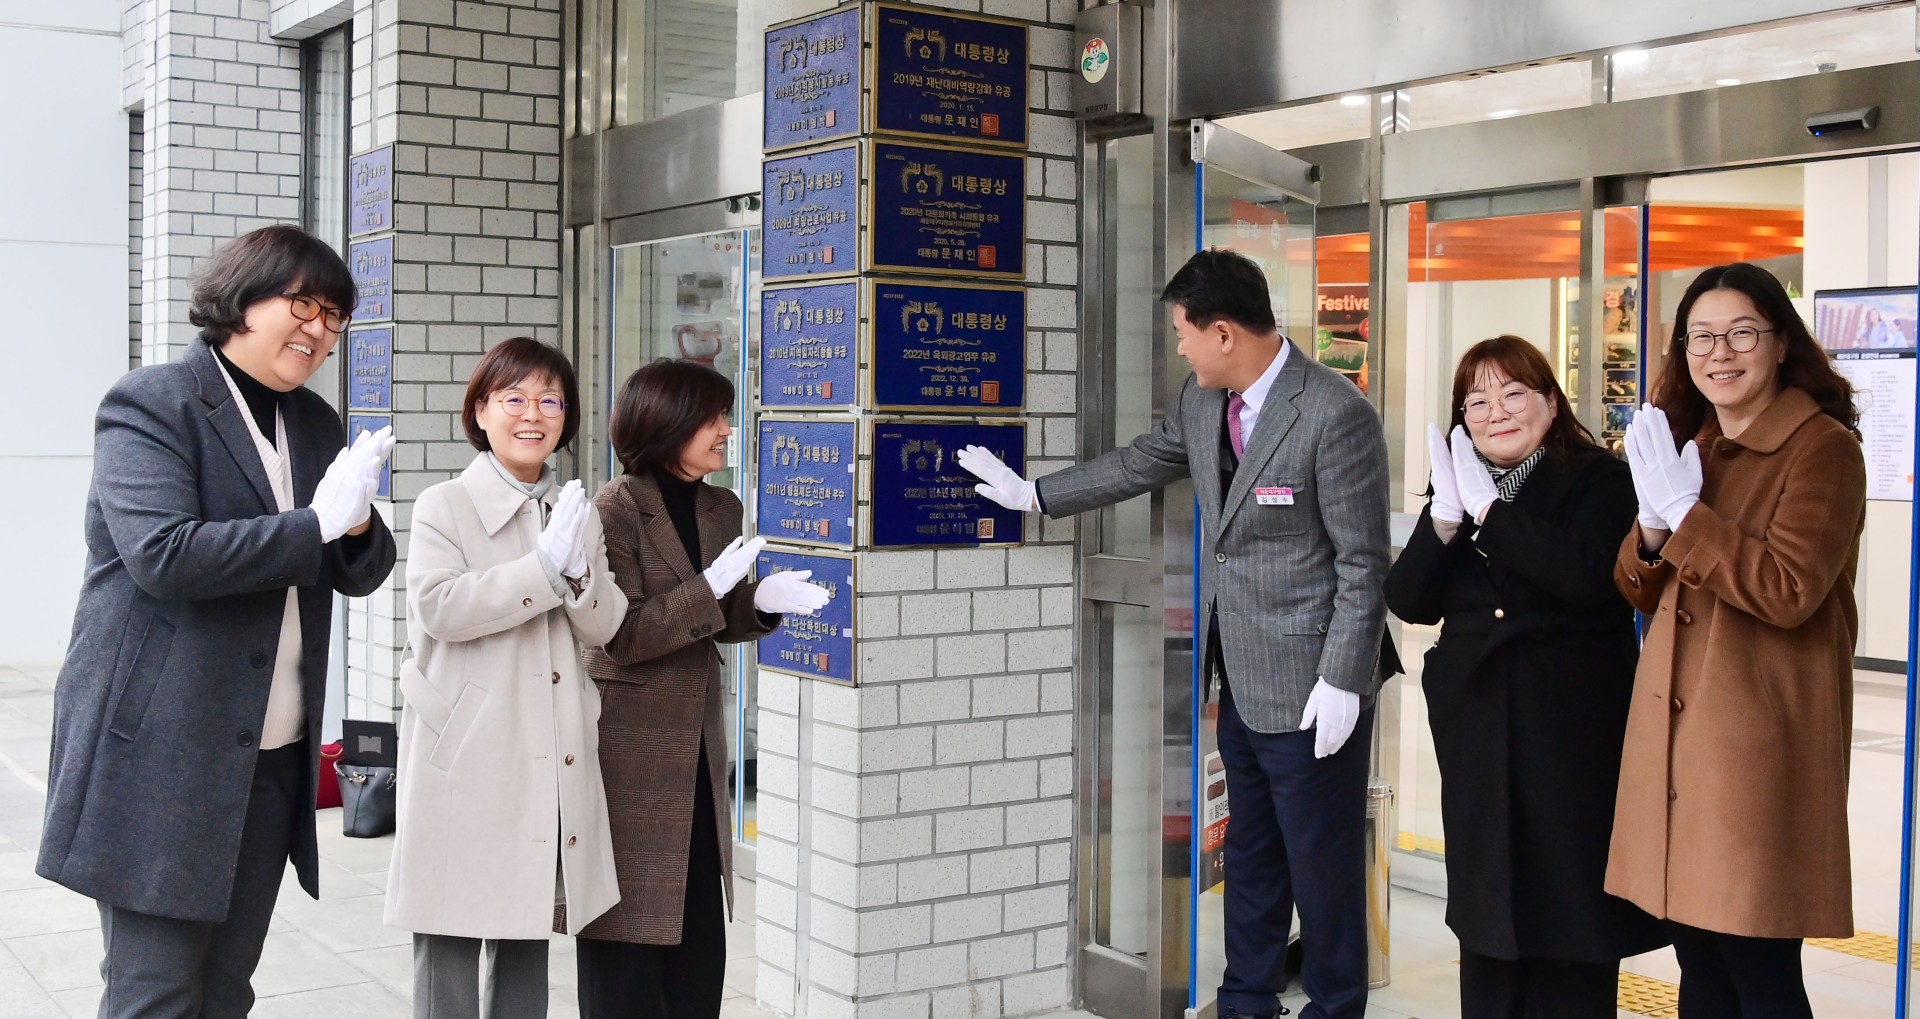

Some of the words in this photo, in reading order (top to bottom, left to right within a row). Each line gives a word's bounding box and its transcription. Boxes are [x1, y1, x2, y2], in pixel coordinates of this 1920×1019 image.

[809, 33, 846, 56] 대통령상
[954, 42, 1010, 65] 대통령상
[835, 72, 850, 86] 유공
[893, 72, 923, 87] 2019년
[926, 77, 992, 95] 재난대비역량강화
[994, 85, 1012, 98] 유공
[939, 101, 957, 109] 2020.
[920, 113, 942, 125] 대통령
[806, 170, 844, 191] 대통령상
[951, 175, 1007, 196] 대통령상
[833, 210, 847, 223] 유공
[900, 207, 923, 217] 2020년
[986, 213, 1000, 223] 유공
[917, 247, 939, 258] 대통령
[806, 307, 845, 325] 대통령상
[951, 312, 1007, 331] 대통령상
[769, 347, 789, 359] 2010년
[834, 345, 848, 359] 유공
[902, 349, 931, 360] 2022년
[932, 351, 979, 362] 옥외광고업무
[981, 352, 997, 363] 유공
[920, 386, 942, 397] 대통령
[803, 445, 840, 464] 대통령상
[766, 483, 786, 497] 2011년
[832, 488, 845, 502] 우수
